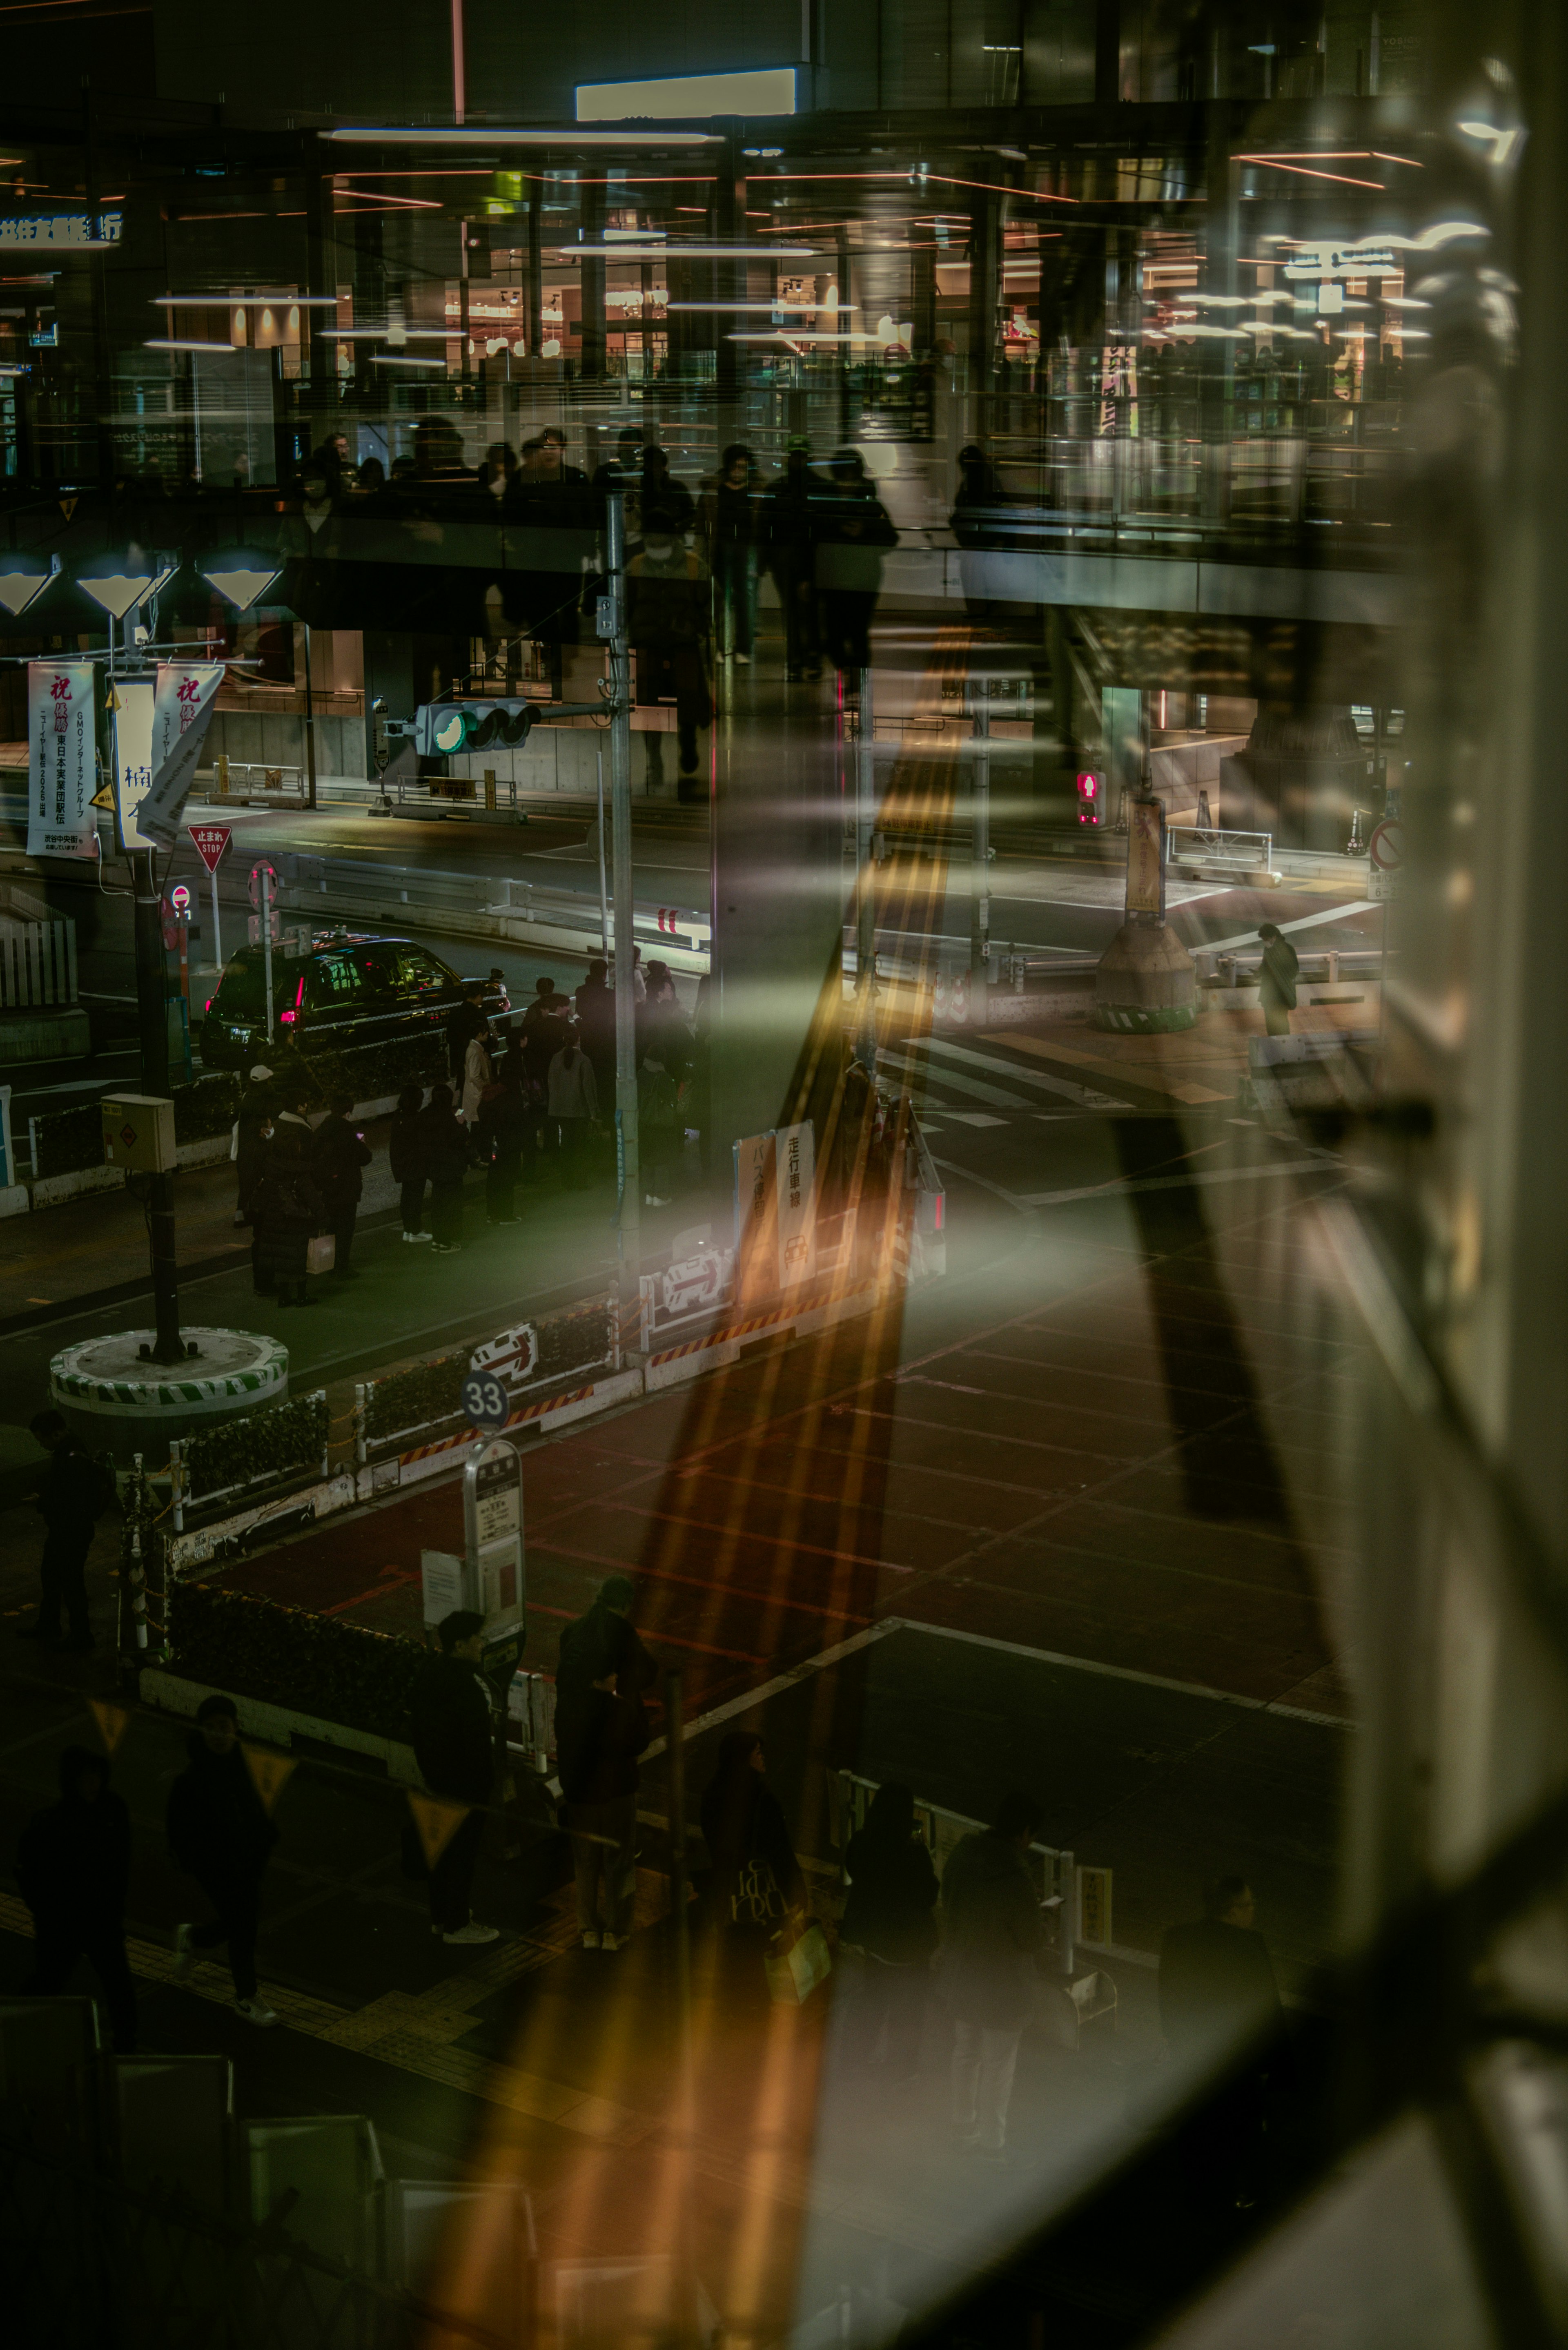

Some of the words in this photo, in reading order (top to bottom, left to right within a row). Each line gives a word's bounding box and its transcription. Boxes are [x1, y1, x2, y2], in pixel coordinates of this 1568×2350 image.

[50, 675, 72, 700] 祝
[176, 677, 201, 702] 祝
[54, 702, 68, 732] 優勝
[56, 735, 66, 824] 東日本実業団駅伝
[39, 803, 46, 817] 出場
[197, 831, 223, 842] 止まれ
[202, 844, 221, 854] STOP
[788, 1137, 800, 1208] 走行車線
[467, 1382, 502, 1415] 33
